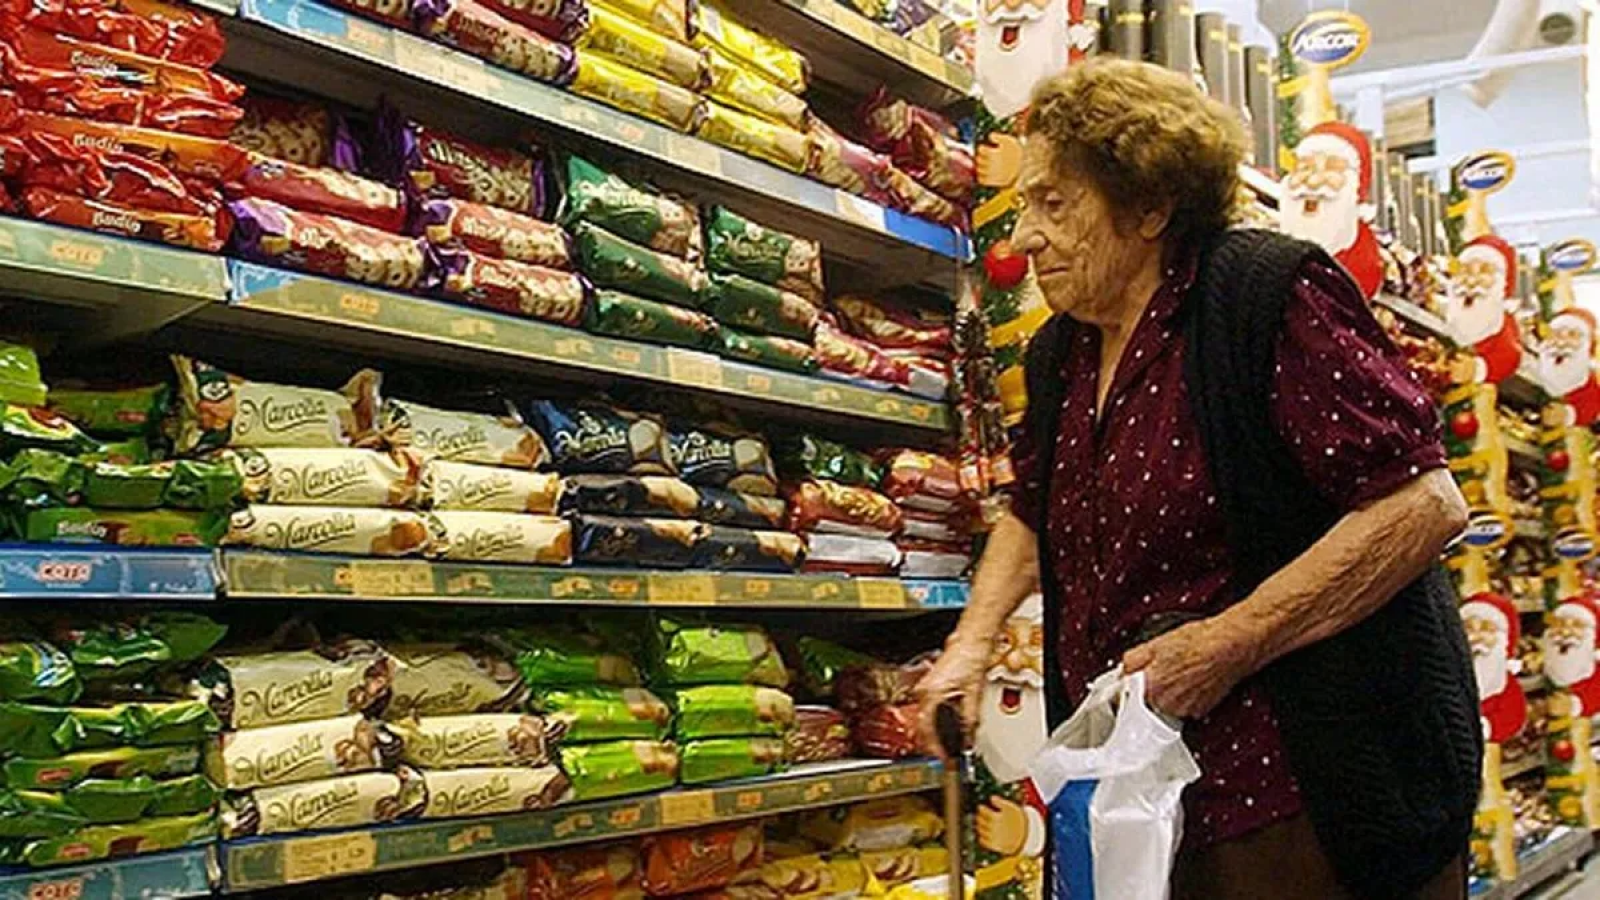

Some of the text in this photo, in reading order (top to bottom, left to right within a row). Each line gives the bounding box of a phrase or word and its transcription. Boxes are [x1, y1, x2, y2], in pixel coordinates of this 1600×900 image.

[236, 395, 329, 434] Marcolla
[238, 670, 334, 726] Marcolla
[232, 733, 326, 784] Marcolla
